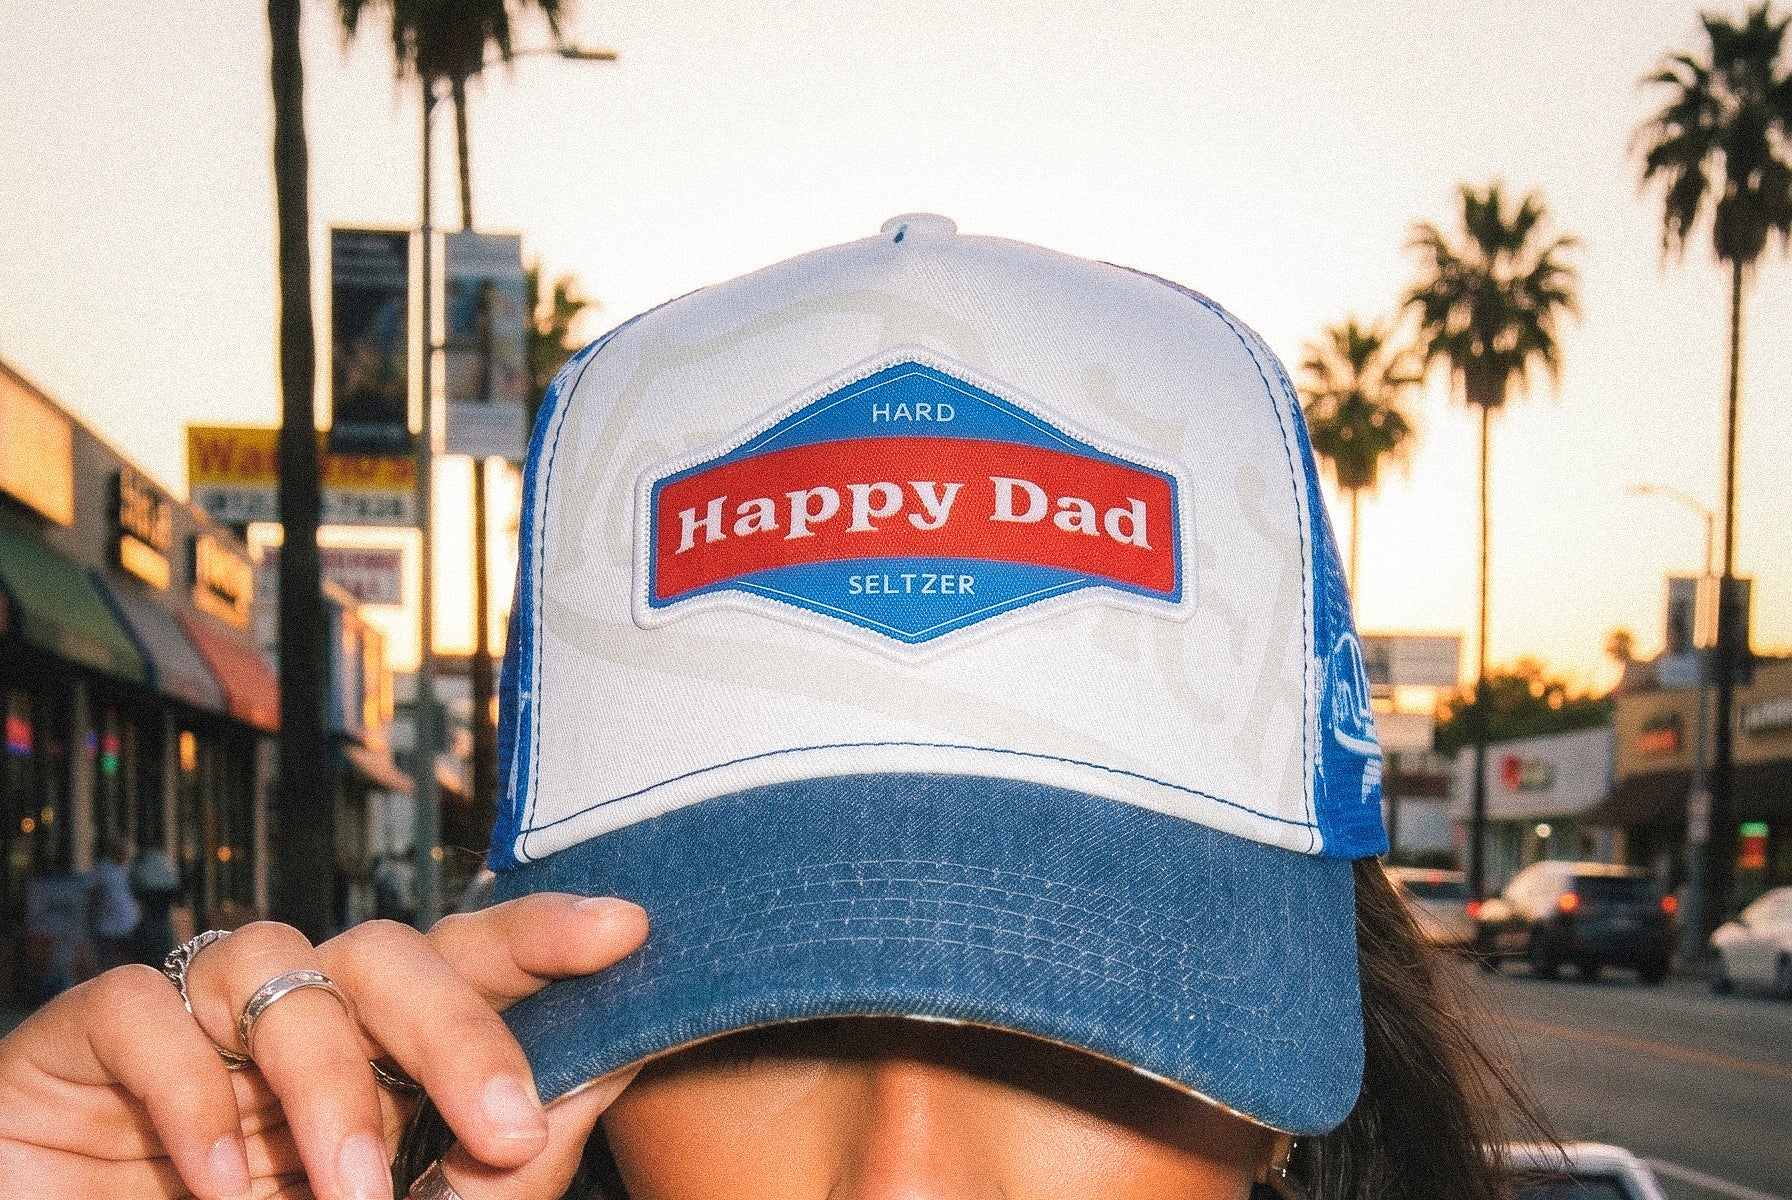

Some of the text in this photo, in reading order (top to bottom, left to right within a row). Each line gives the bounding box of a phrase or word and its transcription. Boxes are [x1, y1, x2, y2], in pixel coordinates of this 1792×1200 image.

[872, 402, 956, 423] HARD
[674, 475, 1153, 555] Happy Dad
[848, 572, 976, 595] SELTZER
